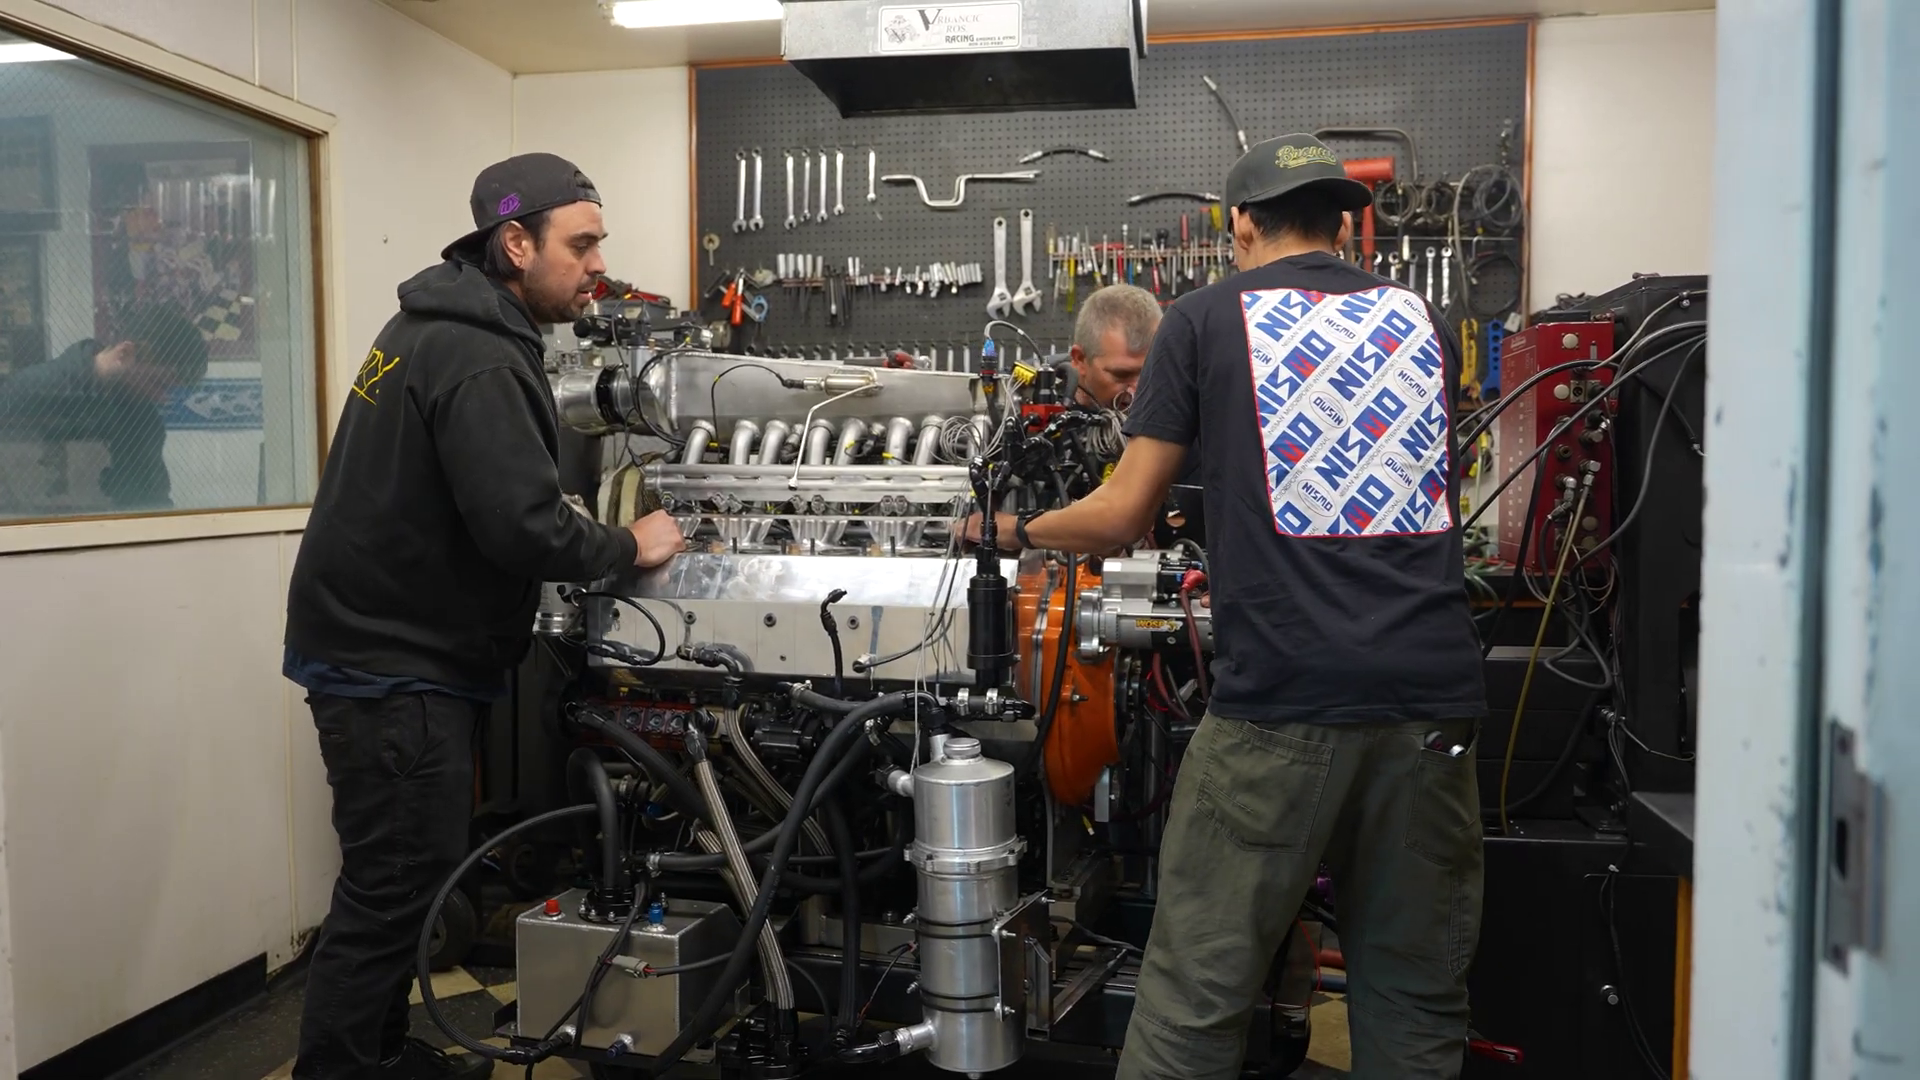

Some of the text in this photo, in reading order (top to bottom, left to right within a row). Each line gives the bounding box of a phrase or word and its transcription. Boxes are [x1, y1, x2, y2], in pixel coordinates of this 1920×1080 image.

[945, 35, 974, 43] RACING
[1324, 318, 1356, 339] NISMO
[1327, 309, 1418, 402] NISMO
[1397, 370, 1427, 398] NISMO
[1266, 414, 1286, 435] NISSAN
[1313, 397, 1344, 426] NISMO
[1314, 386, 1408, 493] NISMO
[1384, 457, 1412, 486] NISMO
[1301, 482, 1333, 511] NISMO
